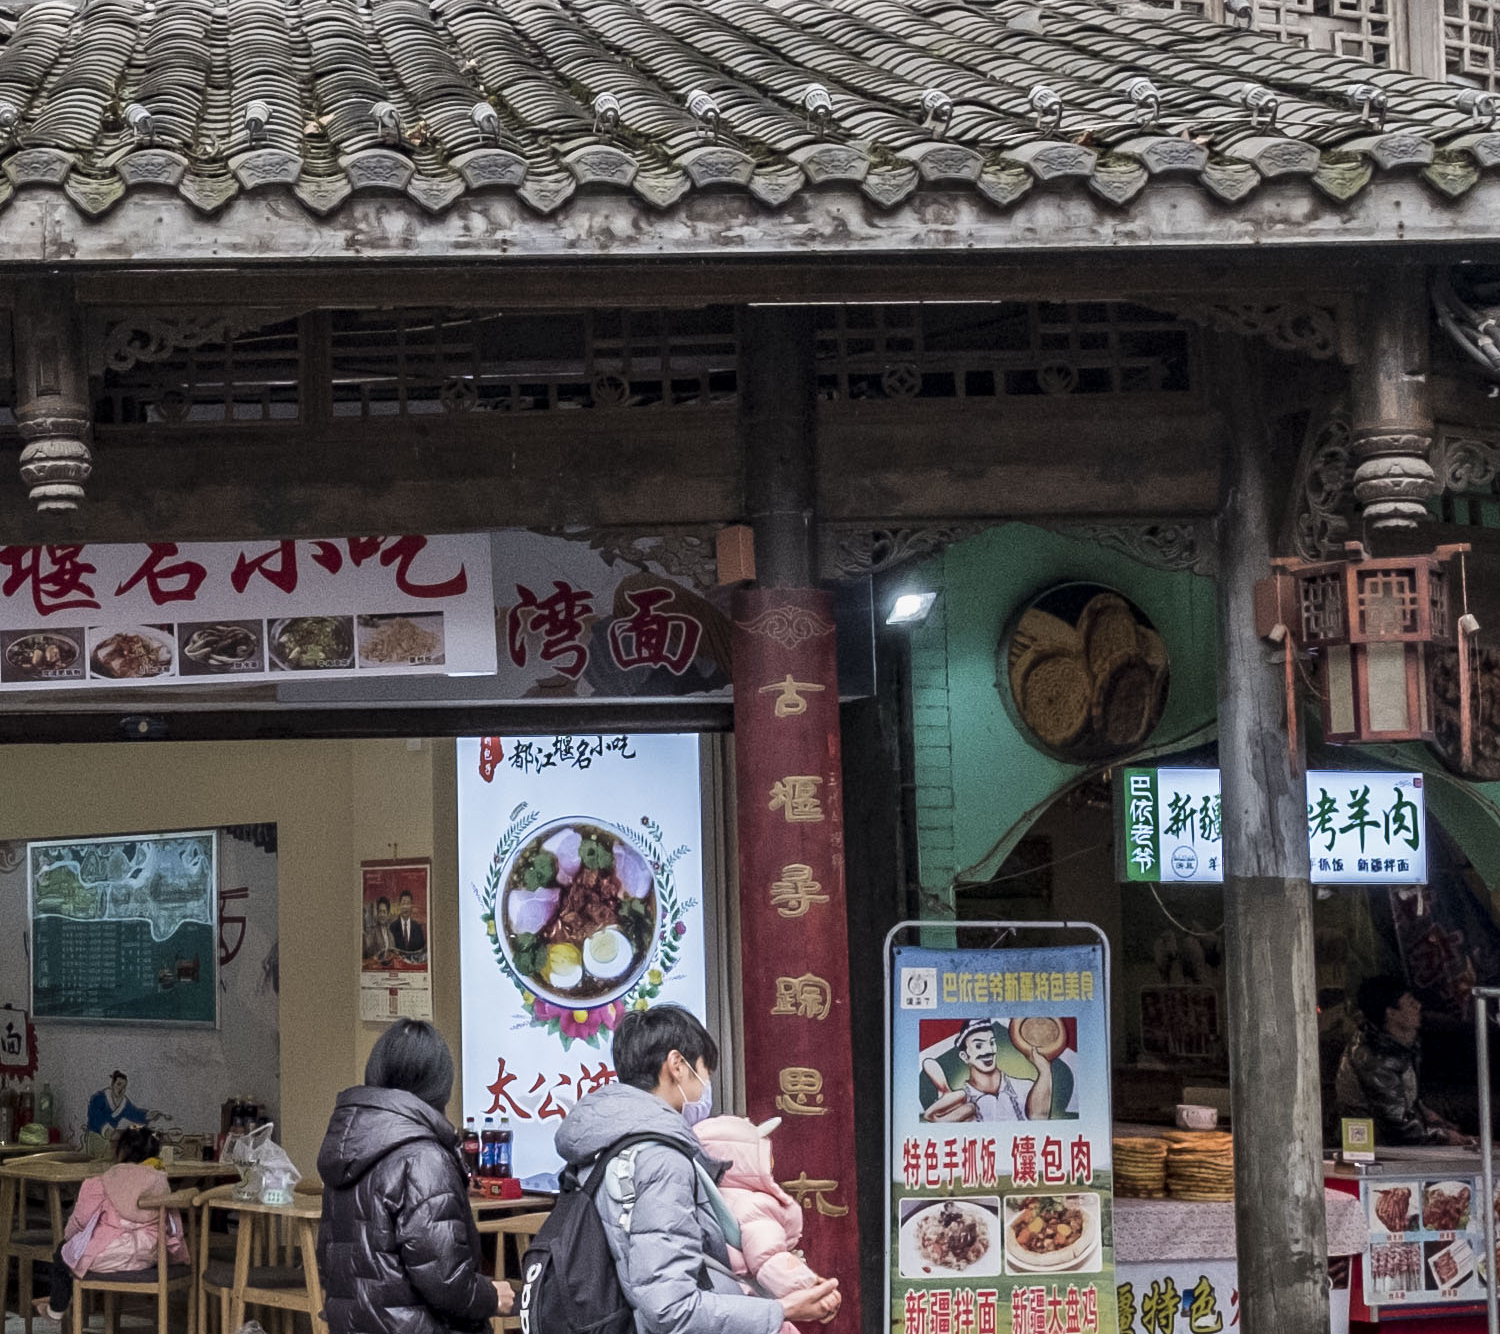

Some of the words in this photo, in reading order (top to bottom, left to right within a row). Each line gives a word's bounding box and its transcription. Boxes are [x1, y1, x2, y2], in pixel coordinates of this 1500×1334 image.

[508, 579, 702, 681] 湾面
[507, 734, 637, 774] 都江堰名小吃
[1130, 776, 1155, 873] 巴依老爷
[943, 971, 1095, 1003] 巴依老爷新疆特色美食
[903, 1138, 998, 1189] 特色手抓饭
[1011, 1134, 1092, 1183] 馕包肉
